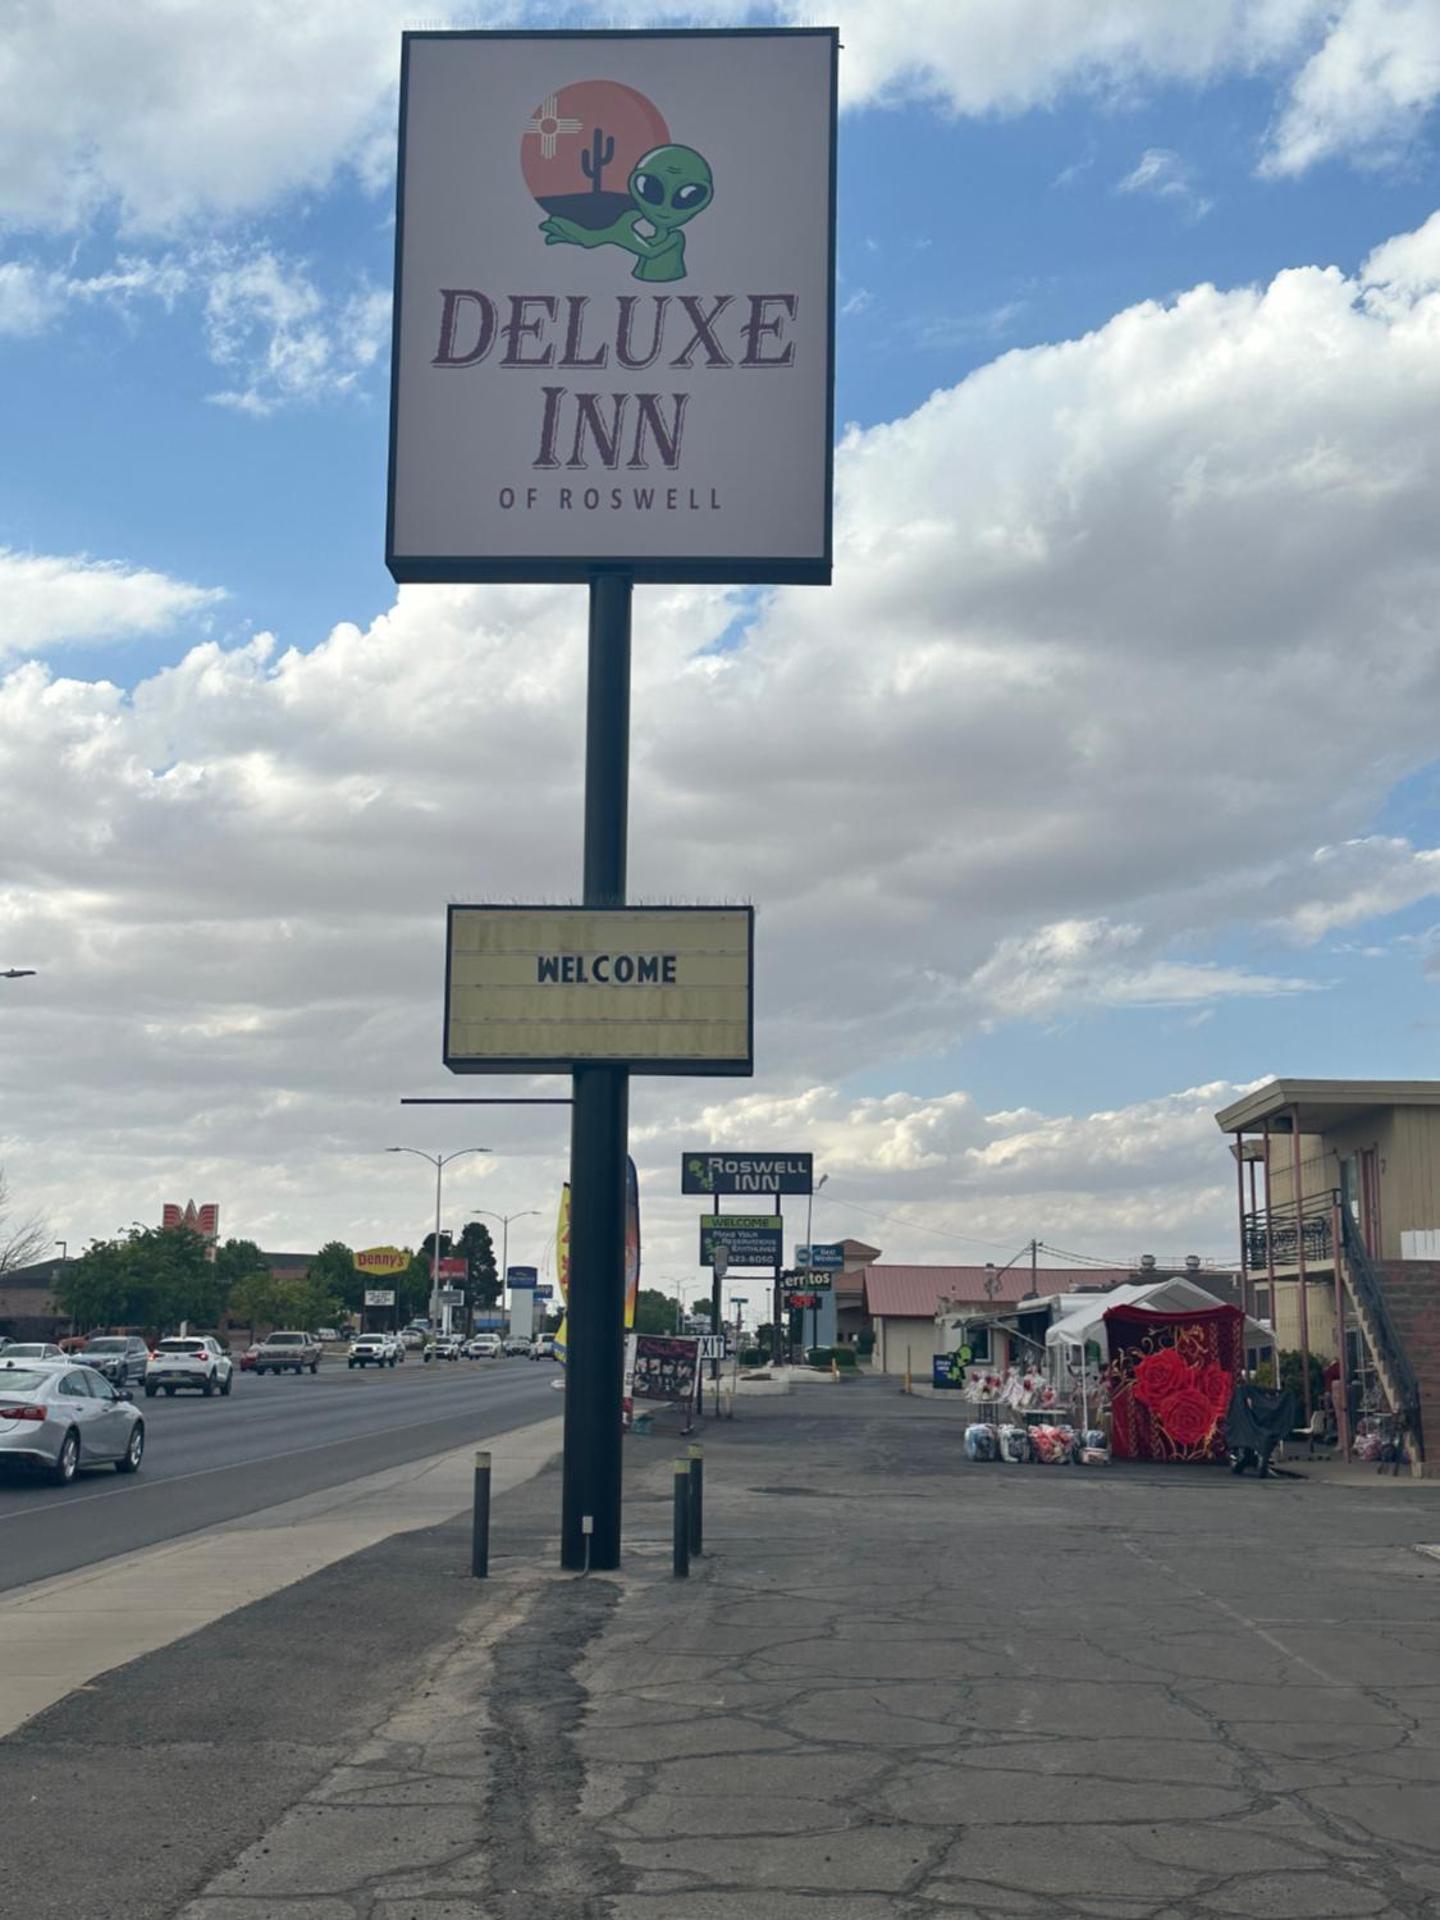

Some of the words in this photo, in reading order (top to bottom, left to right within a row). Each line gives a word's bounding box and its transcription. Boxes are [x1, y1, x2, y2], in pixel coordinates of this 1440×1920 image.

[431, 288, 799, 369] DELUXE
[532, 386, 690, 470] INN
[499, 488, 539, 511] OF
[559, 487, 722, 511] ROSWELL
[537, 955, 677, 984] WELCOME
[708, 1157, 807, 1174] ROSWELL
[735, 1174, 780, 1191] INN
[711, 1218, 769, 1228] WELCOME
[358, 1253, 405, 1268] Denny's
